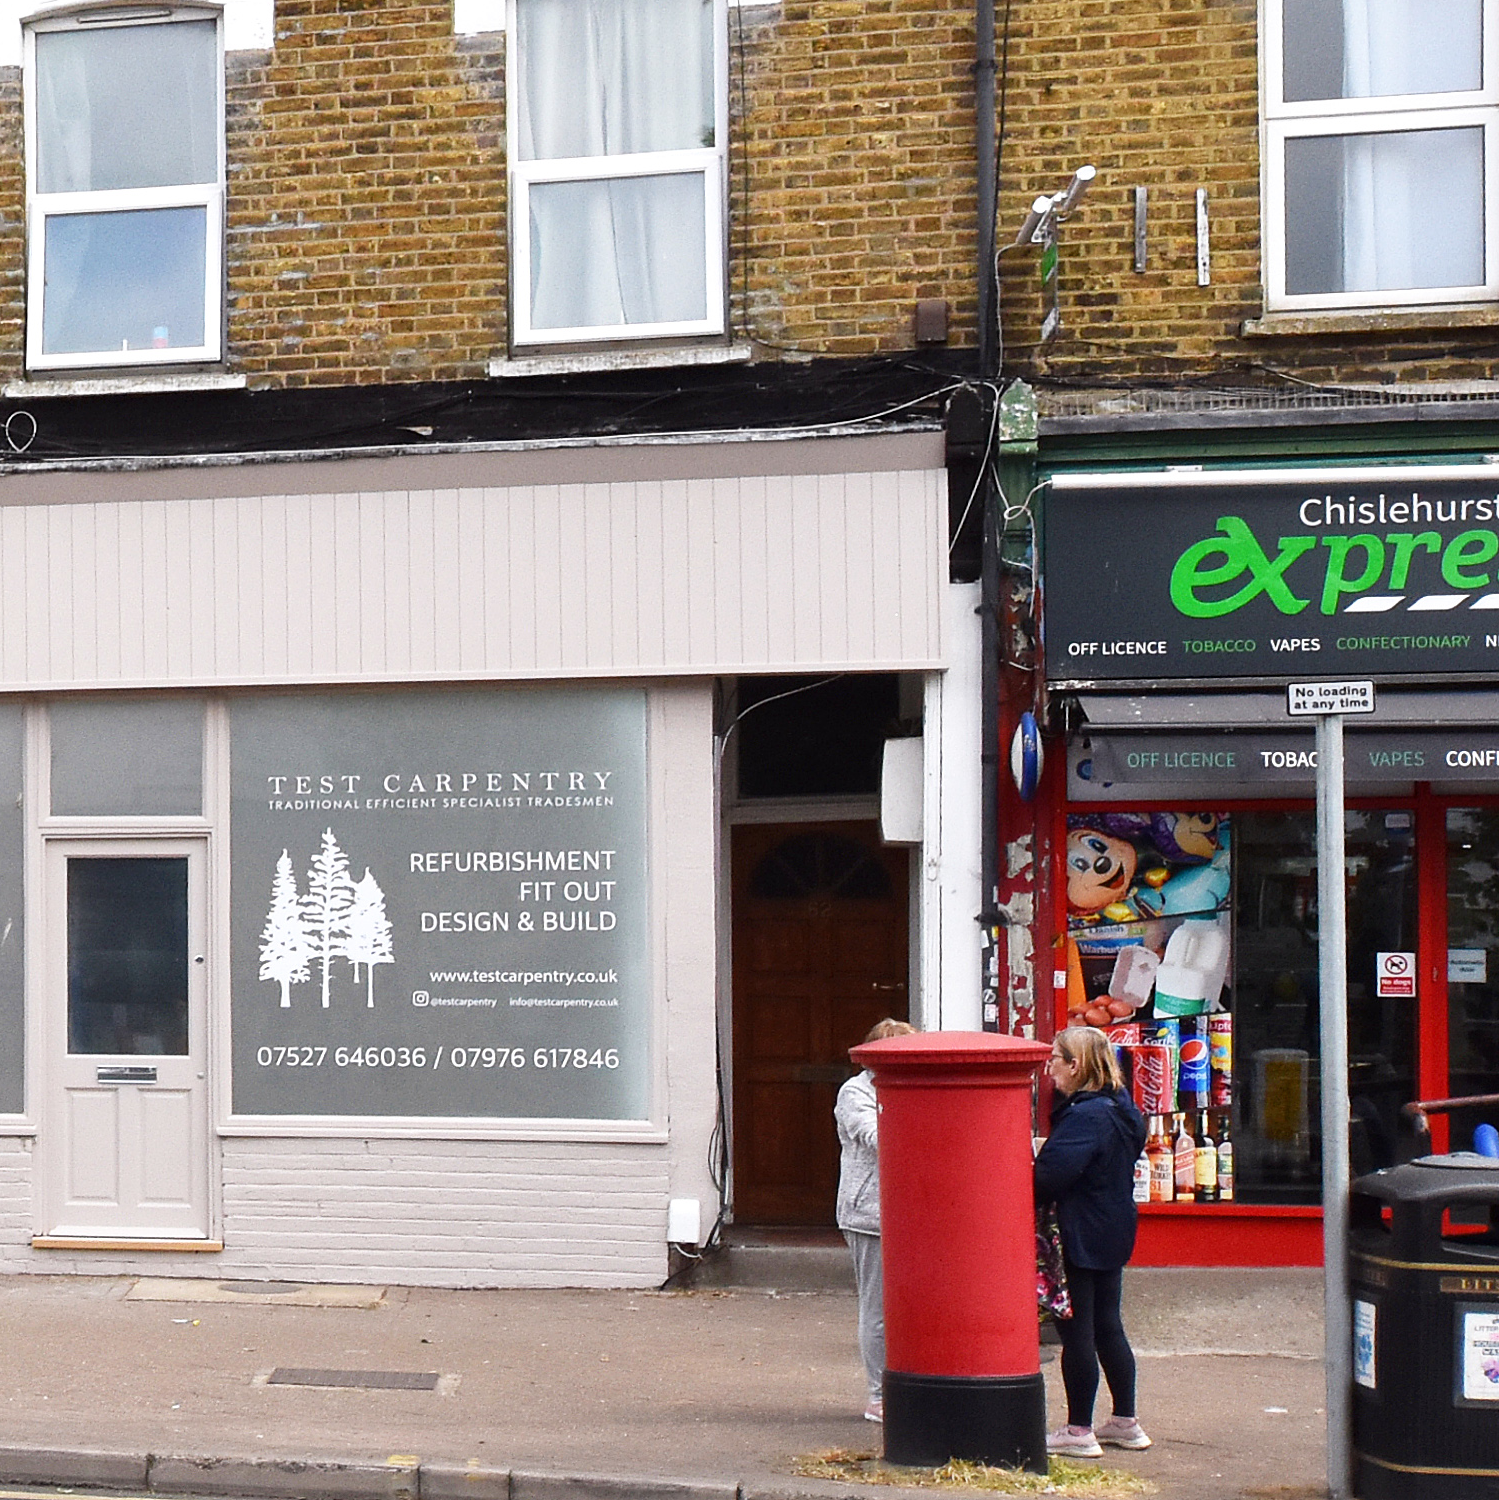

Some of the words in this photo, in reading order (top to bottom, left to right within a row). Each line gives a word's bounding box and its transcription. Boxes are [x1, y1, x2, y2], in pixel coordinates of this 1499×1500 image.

[1169, 515, 1499, 618] expre
[1068, 642, 1099, 656] OFF
[1101, 640, 1167, 655] LICENCE
[1182, 639, 1256, 653] TOBACCO
[1270, 638, 1321, 652] VAPES
[1336, 635, 1470, 650] CONFECTIONARY
[1295, 686, 1315, 697] No
[1318, 684, 1368, 699] loading
[1294, 699, 1308, 709] at
[1312, 699, 1336, 711] any
[1339, 697, 1369, 709] time
[1127, 753, 1160, 768] OFF
[1164, 751, 1236, 767] LICENCE
[1369, 751, 1425, 767] VAPES
[1445, 750, 1499, 767] CONF
[268, 775, 360, 794] TEST
[383, 771, 613, 793] CARPENTRY
[268, 799, 359, 810] TRADITIONAL
[366, 798, 437, 809] EFFICIENT
[443, 797, 521, 808] SPECIALIST
[527, 796, 614, 807] TRADESMEN
[410, 850, 616, 873] REFURBISHMENT
[520, 881, 557, 901] FIT
[563, 881, 616, 901] OUT
[421, 911, 509, 932] DESIGN
[517, 911, 534, 931] &
[543, 910, 617, 931] BUILD
[430, 969, 618, 986] www.testcarpentry.co.uk
[1393, 978, 1411, 986] dogs
[257, 1046, 327, 1067] 07527
[334, 1046, 427, 1068] 646036
[451, 1047, 526, 1068] 07976
[533, 1047, 619, 1069] 617846
